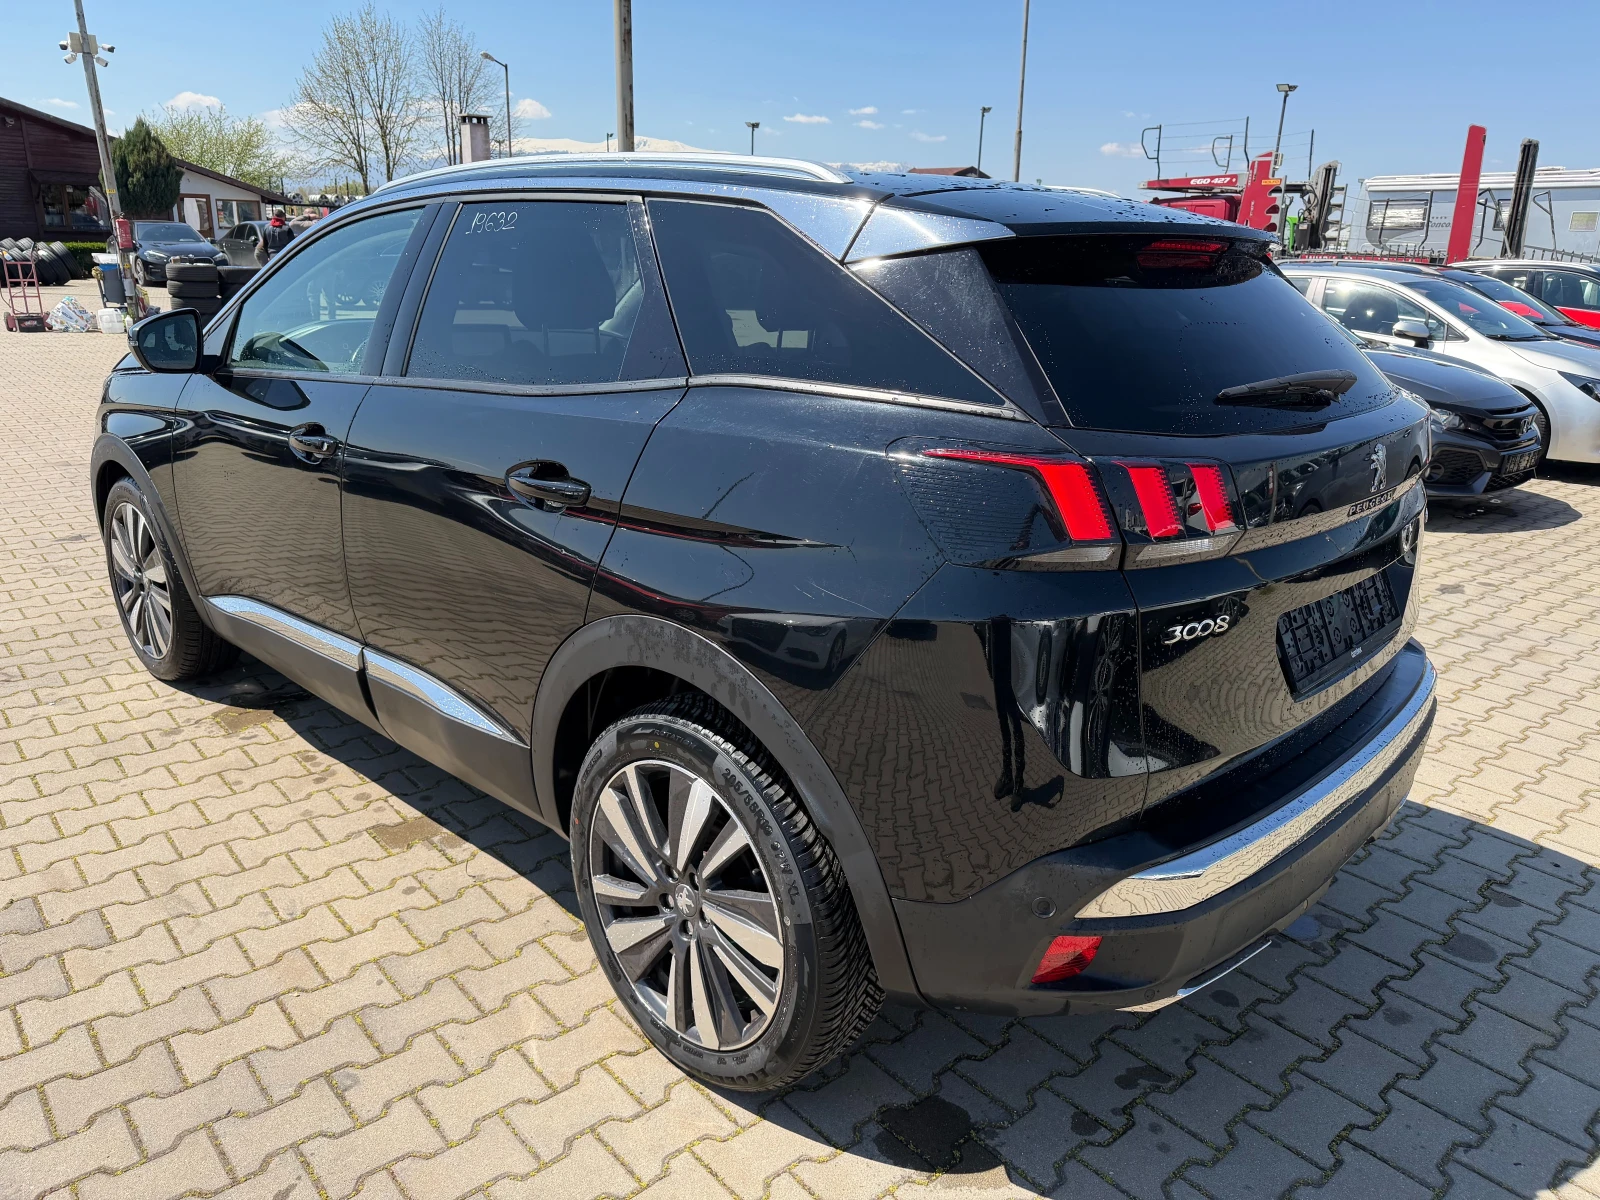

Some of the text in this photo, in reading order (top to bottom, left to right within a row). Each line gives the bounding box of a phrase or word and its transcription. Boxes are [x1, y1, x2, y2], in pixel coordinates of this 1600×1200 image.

[1190, 177, 1211, 185] EGO
[465, 211, 518, 235] 19632
[1164, 615, 1230, 646] 3008
[785, 879, 800, 906] XL
